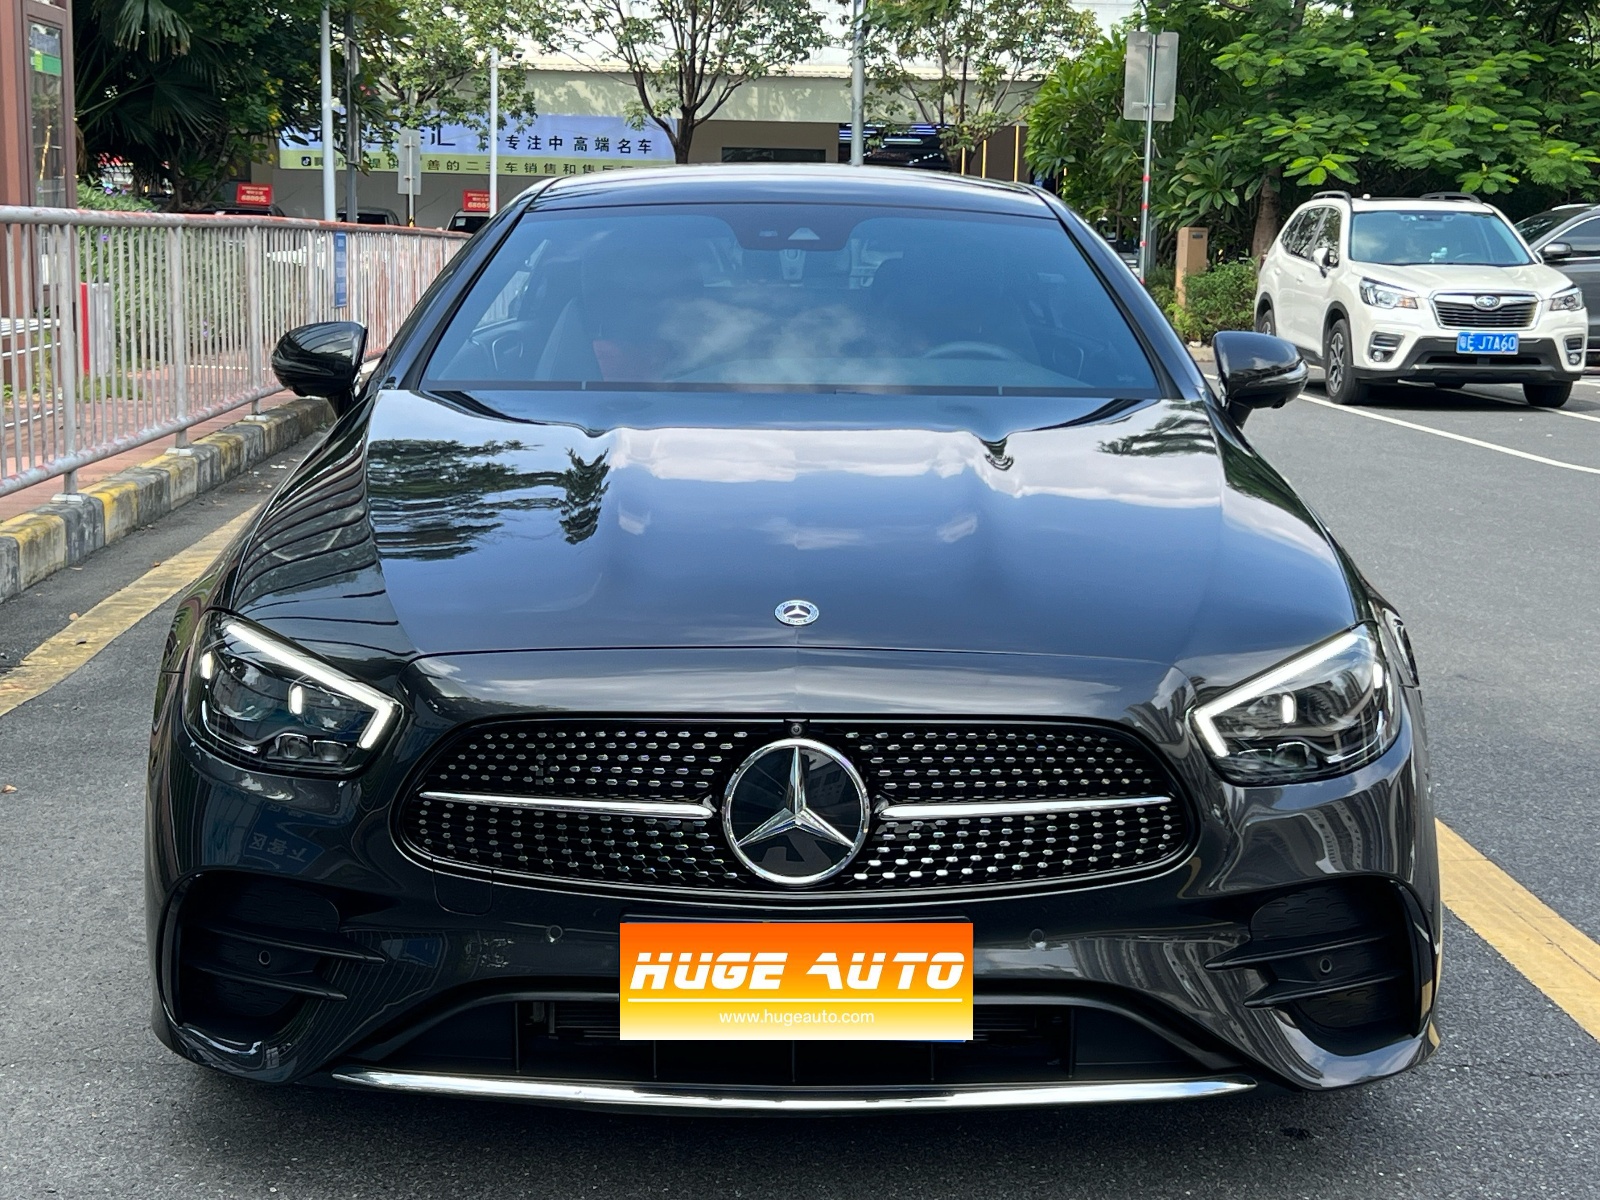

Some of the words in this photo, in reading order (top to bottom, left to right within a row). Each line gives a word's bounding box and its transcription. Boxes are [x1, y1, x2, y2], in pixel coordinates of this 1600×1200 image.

[505, 134, 652, 155] 专注中高端名车
